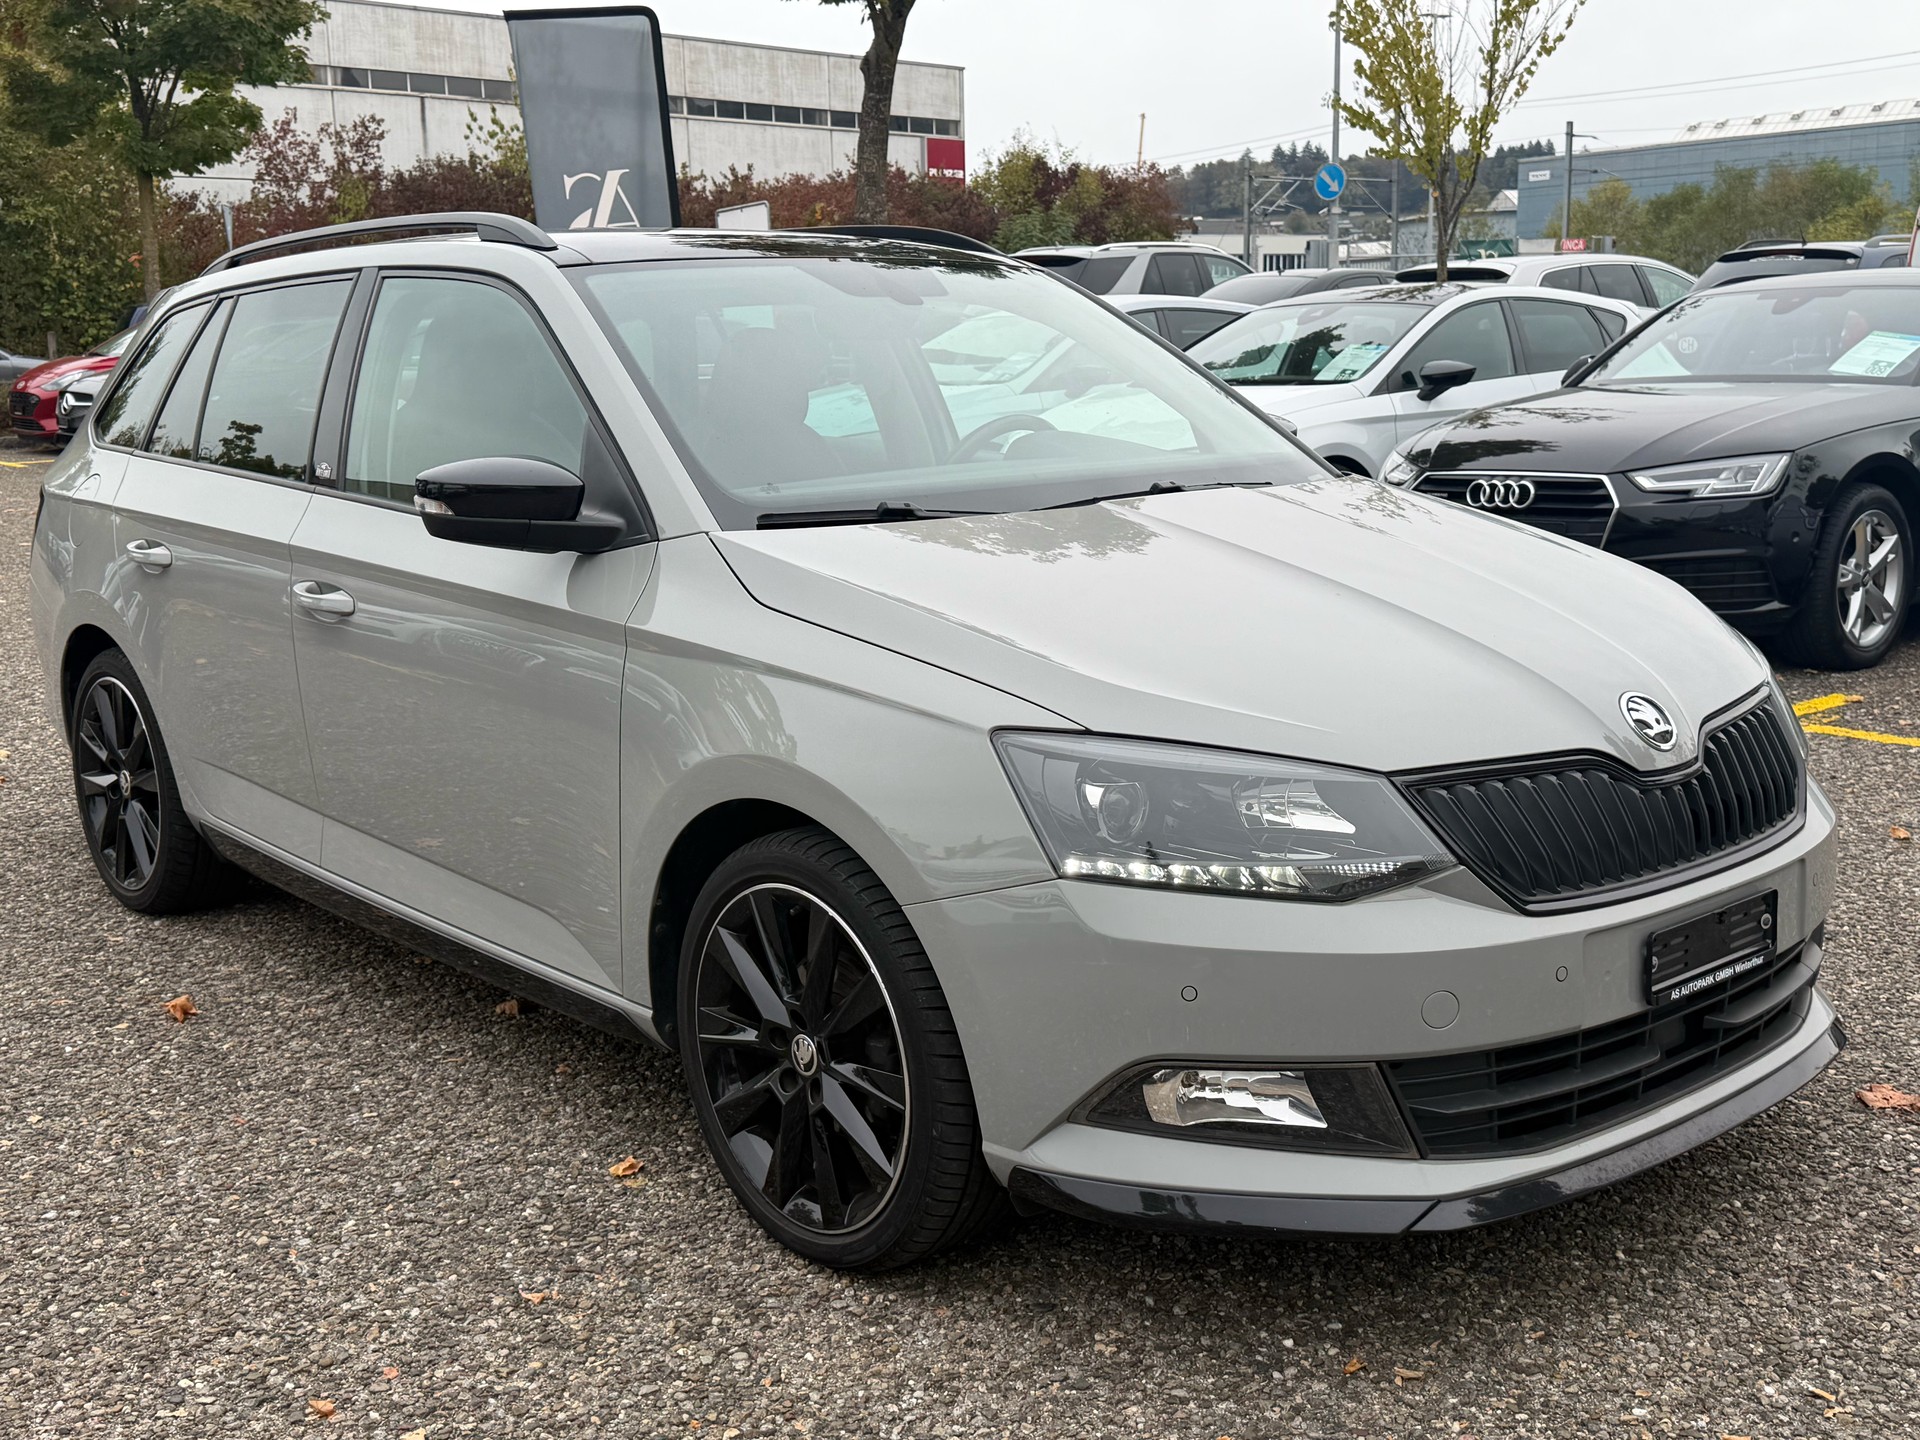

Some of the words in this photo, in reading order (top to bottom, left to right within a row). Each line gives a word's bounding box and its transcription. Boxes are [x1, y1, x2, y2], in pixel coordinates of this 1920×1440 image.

[1681, 338, 1695, 352] CH
[1671, 989, 1681, 1000] AS
[1681, 975, 1714, 996] AUTOPARK
[1715, 967, 1735, 982] GMBH
[1735, 955, 1764, 973] Winterthur
